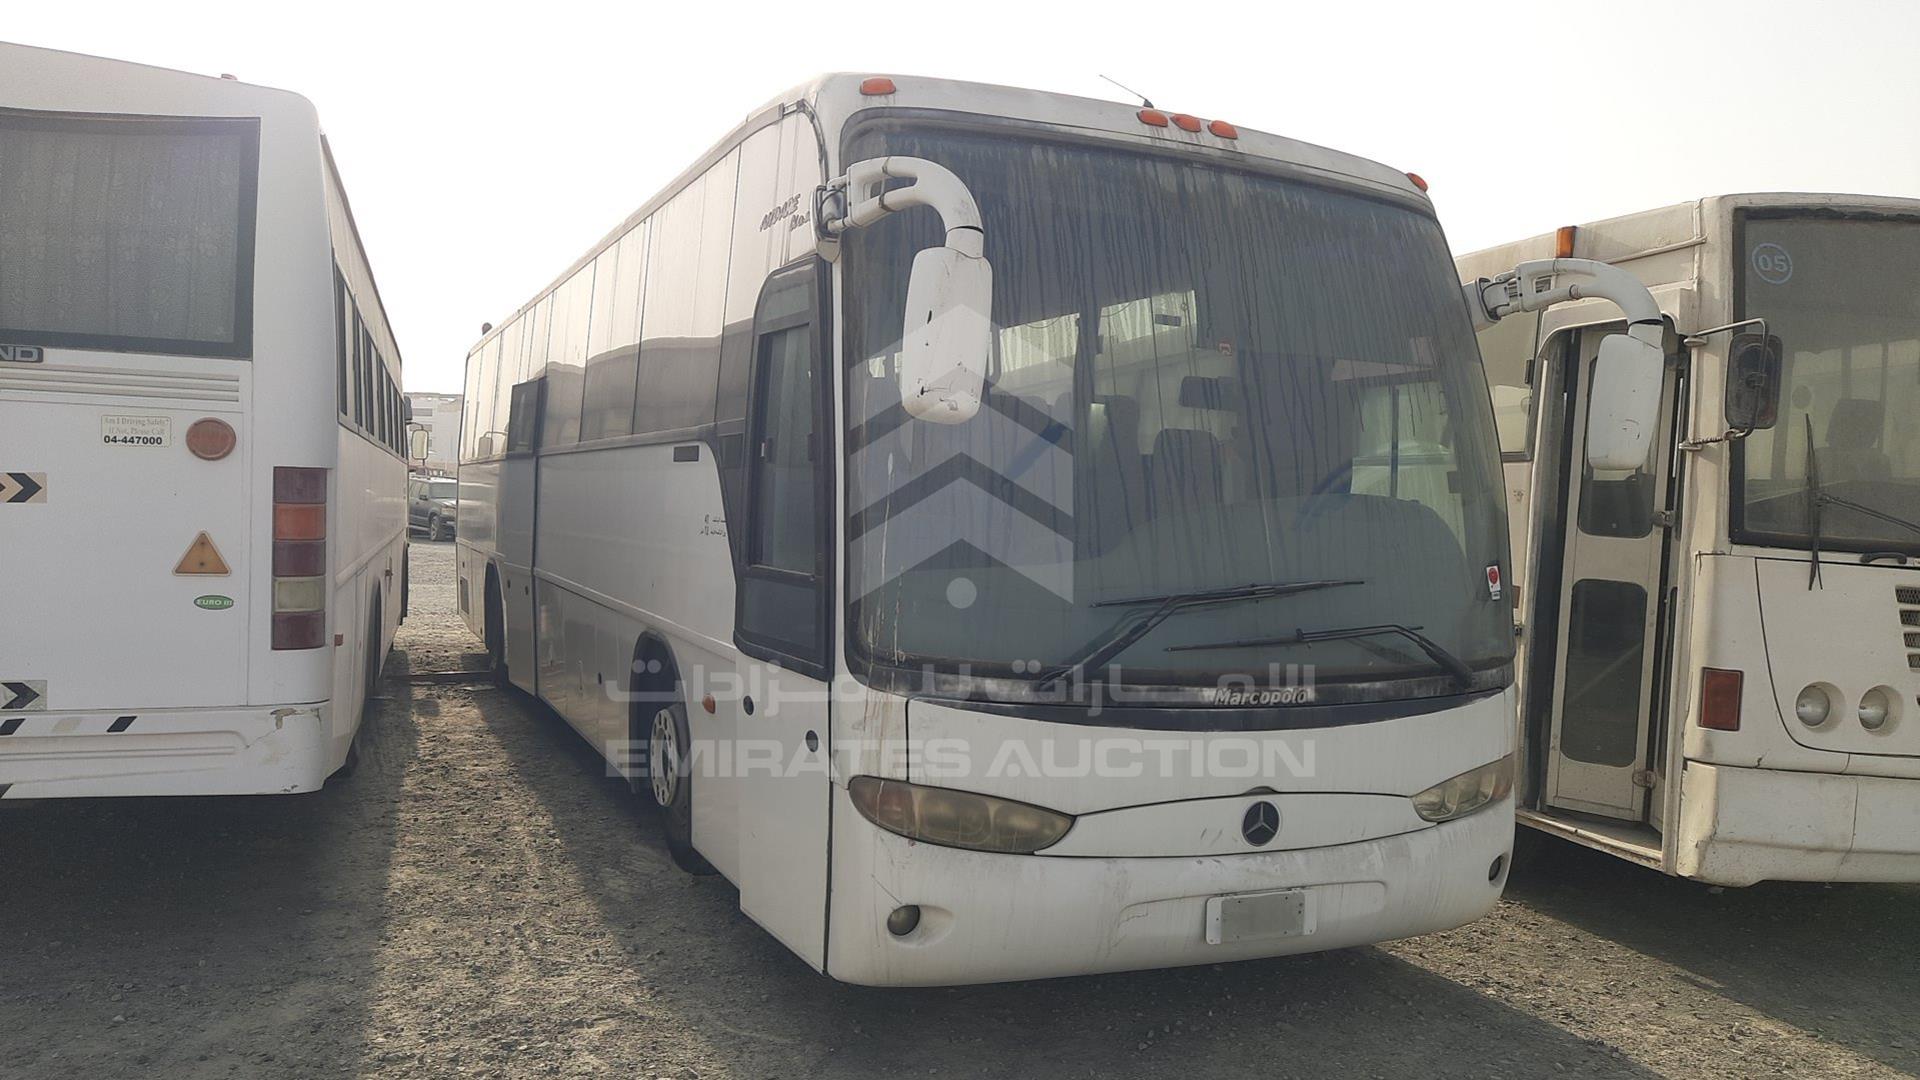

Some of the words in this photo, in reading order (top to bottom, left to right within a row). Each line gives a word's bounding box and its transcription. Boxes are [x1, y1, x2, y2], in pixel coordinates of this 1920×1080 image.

[1758, 254, 1788, 272] 05
[103, 434, 163, 445] 04-447000
[1214, 687, 1309, 706] Marcopolo
